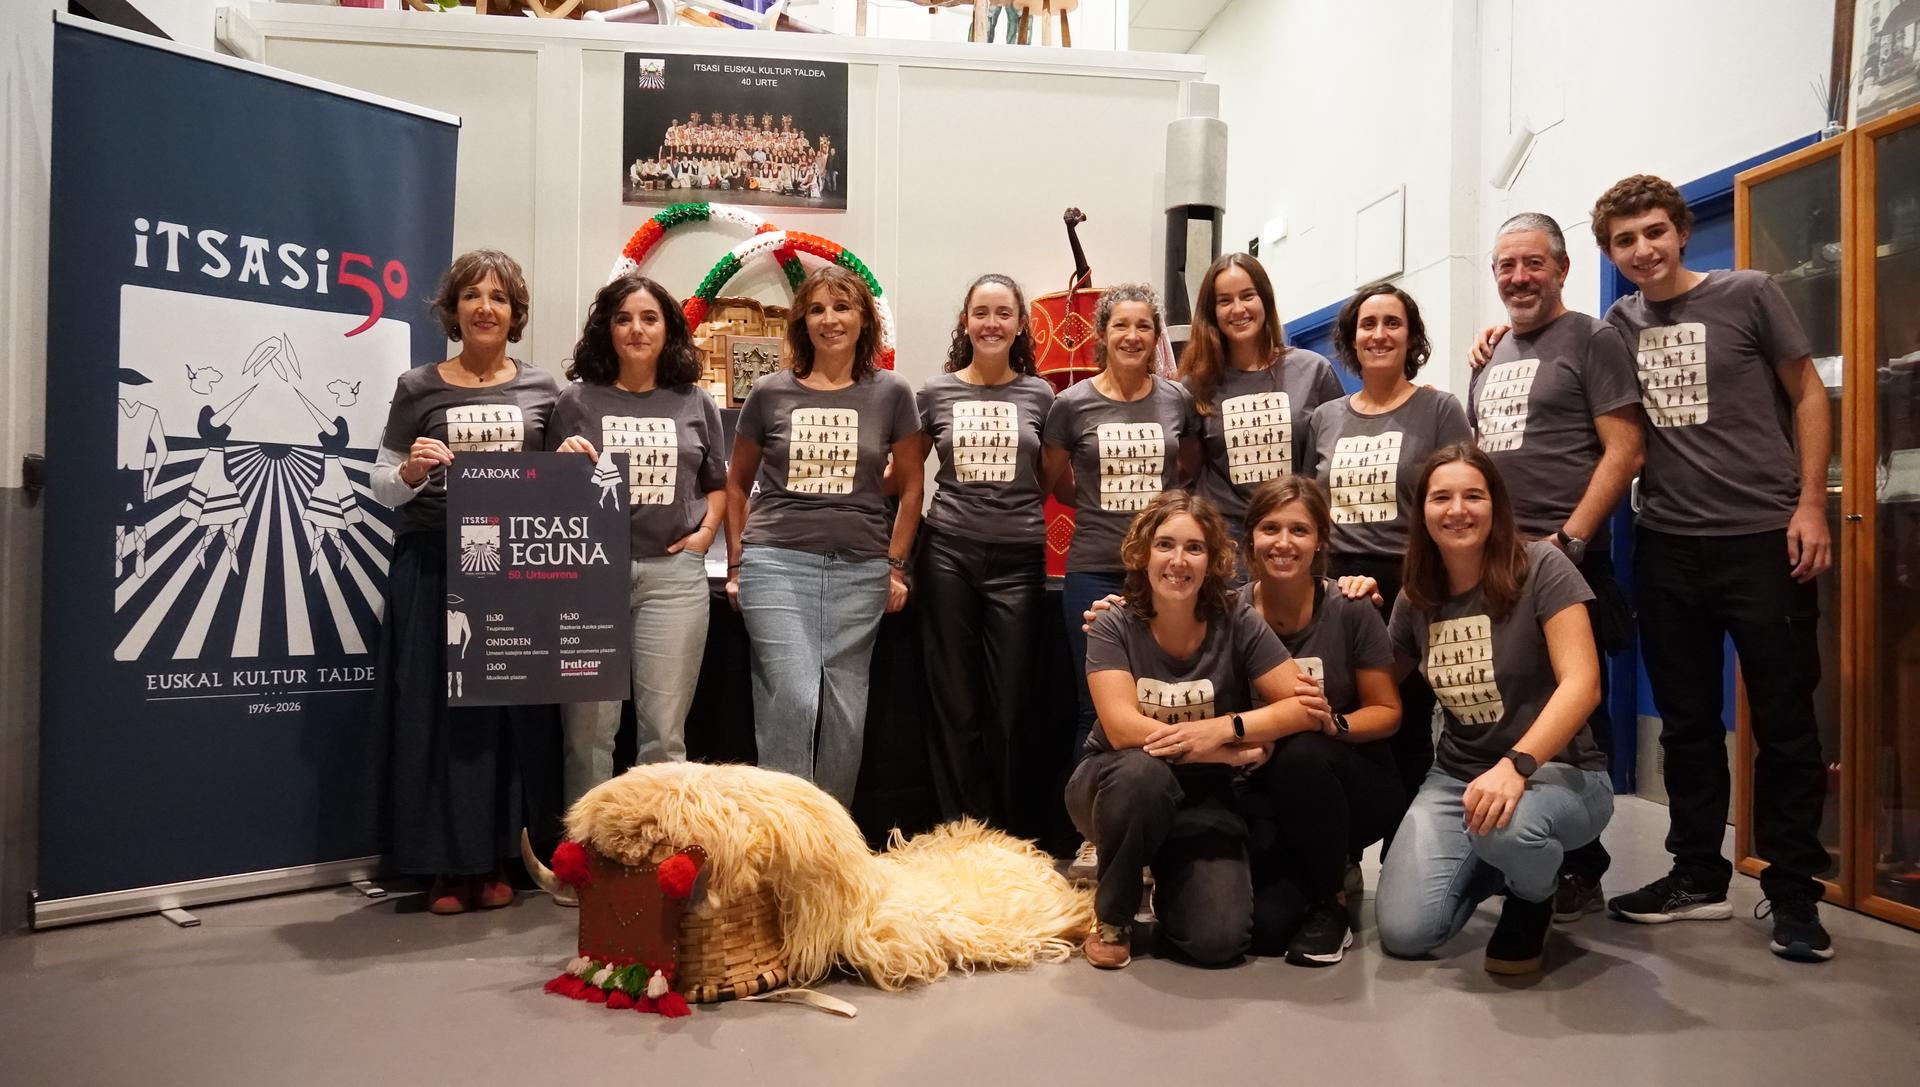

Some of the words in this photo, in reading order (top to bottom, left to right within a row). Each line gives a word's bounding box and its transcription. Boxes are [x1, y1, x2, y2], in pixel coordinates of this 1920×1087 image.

[693, 63, 720, 73] ITSASI
[724, 65, 757, 75] EUSKAL
[758, 66, 792, 76] KULTUR
[794, 68, 826, 78] TALDEA
[741, 78, 751, 86] 40
[755, 79, 778, 87] URTE
[461, 468, 520, 479] AZAROAK
[525, 468, 536, 479] 14
[508, 516, 589, 539] ITSASI
[508, 542, 610, 566] EGUNA
[508, 570, 523, 580] 50.
[485, 613, 504, 622] 11:30
[559, 612, 580, 621] 14:30
[485, 637, 531, 647] ONDOREN
[559, 636, 580, 645] 19:00
[486, 662, 507, 671] 13:00
[146, 672, 223, 690] EUSKAL
[232, 669, 308, 686] KULTUR
